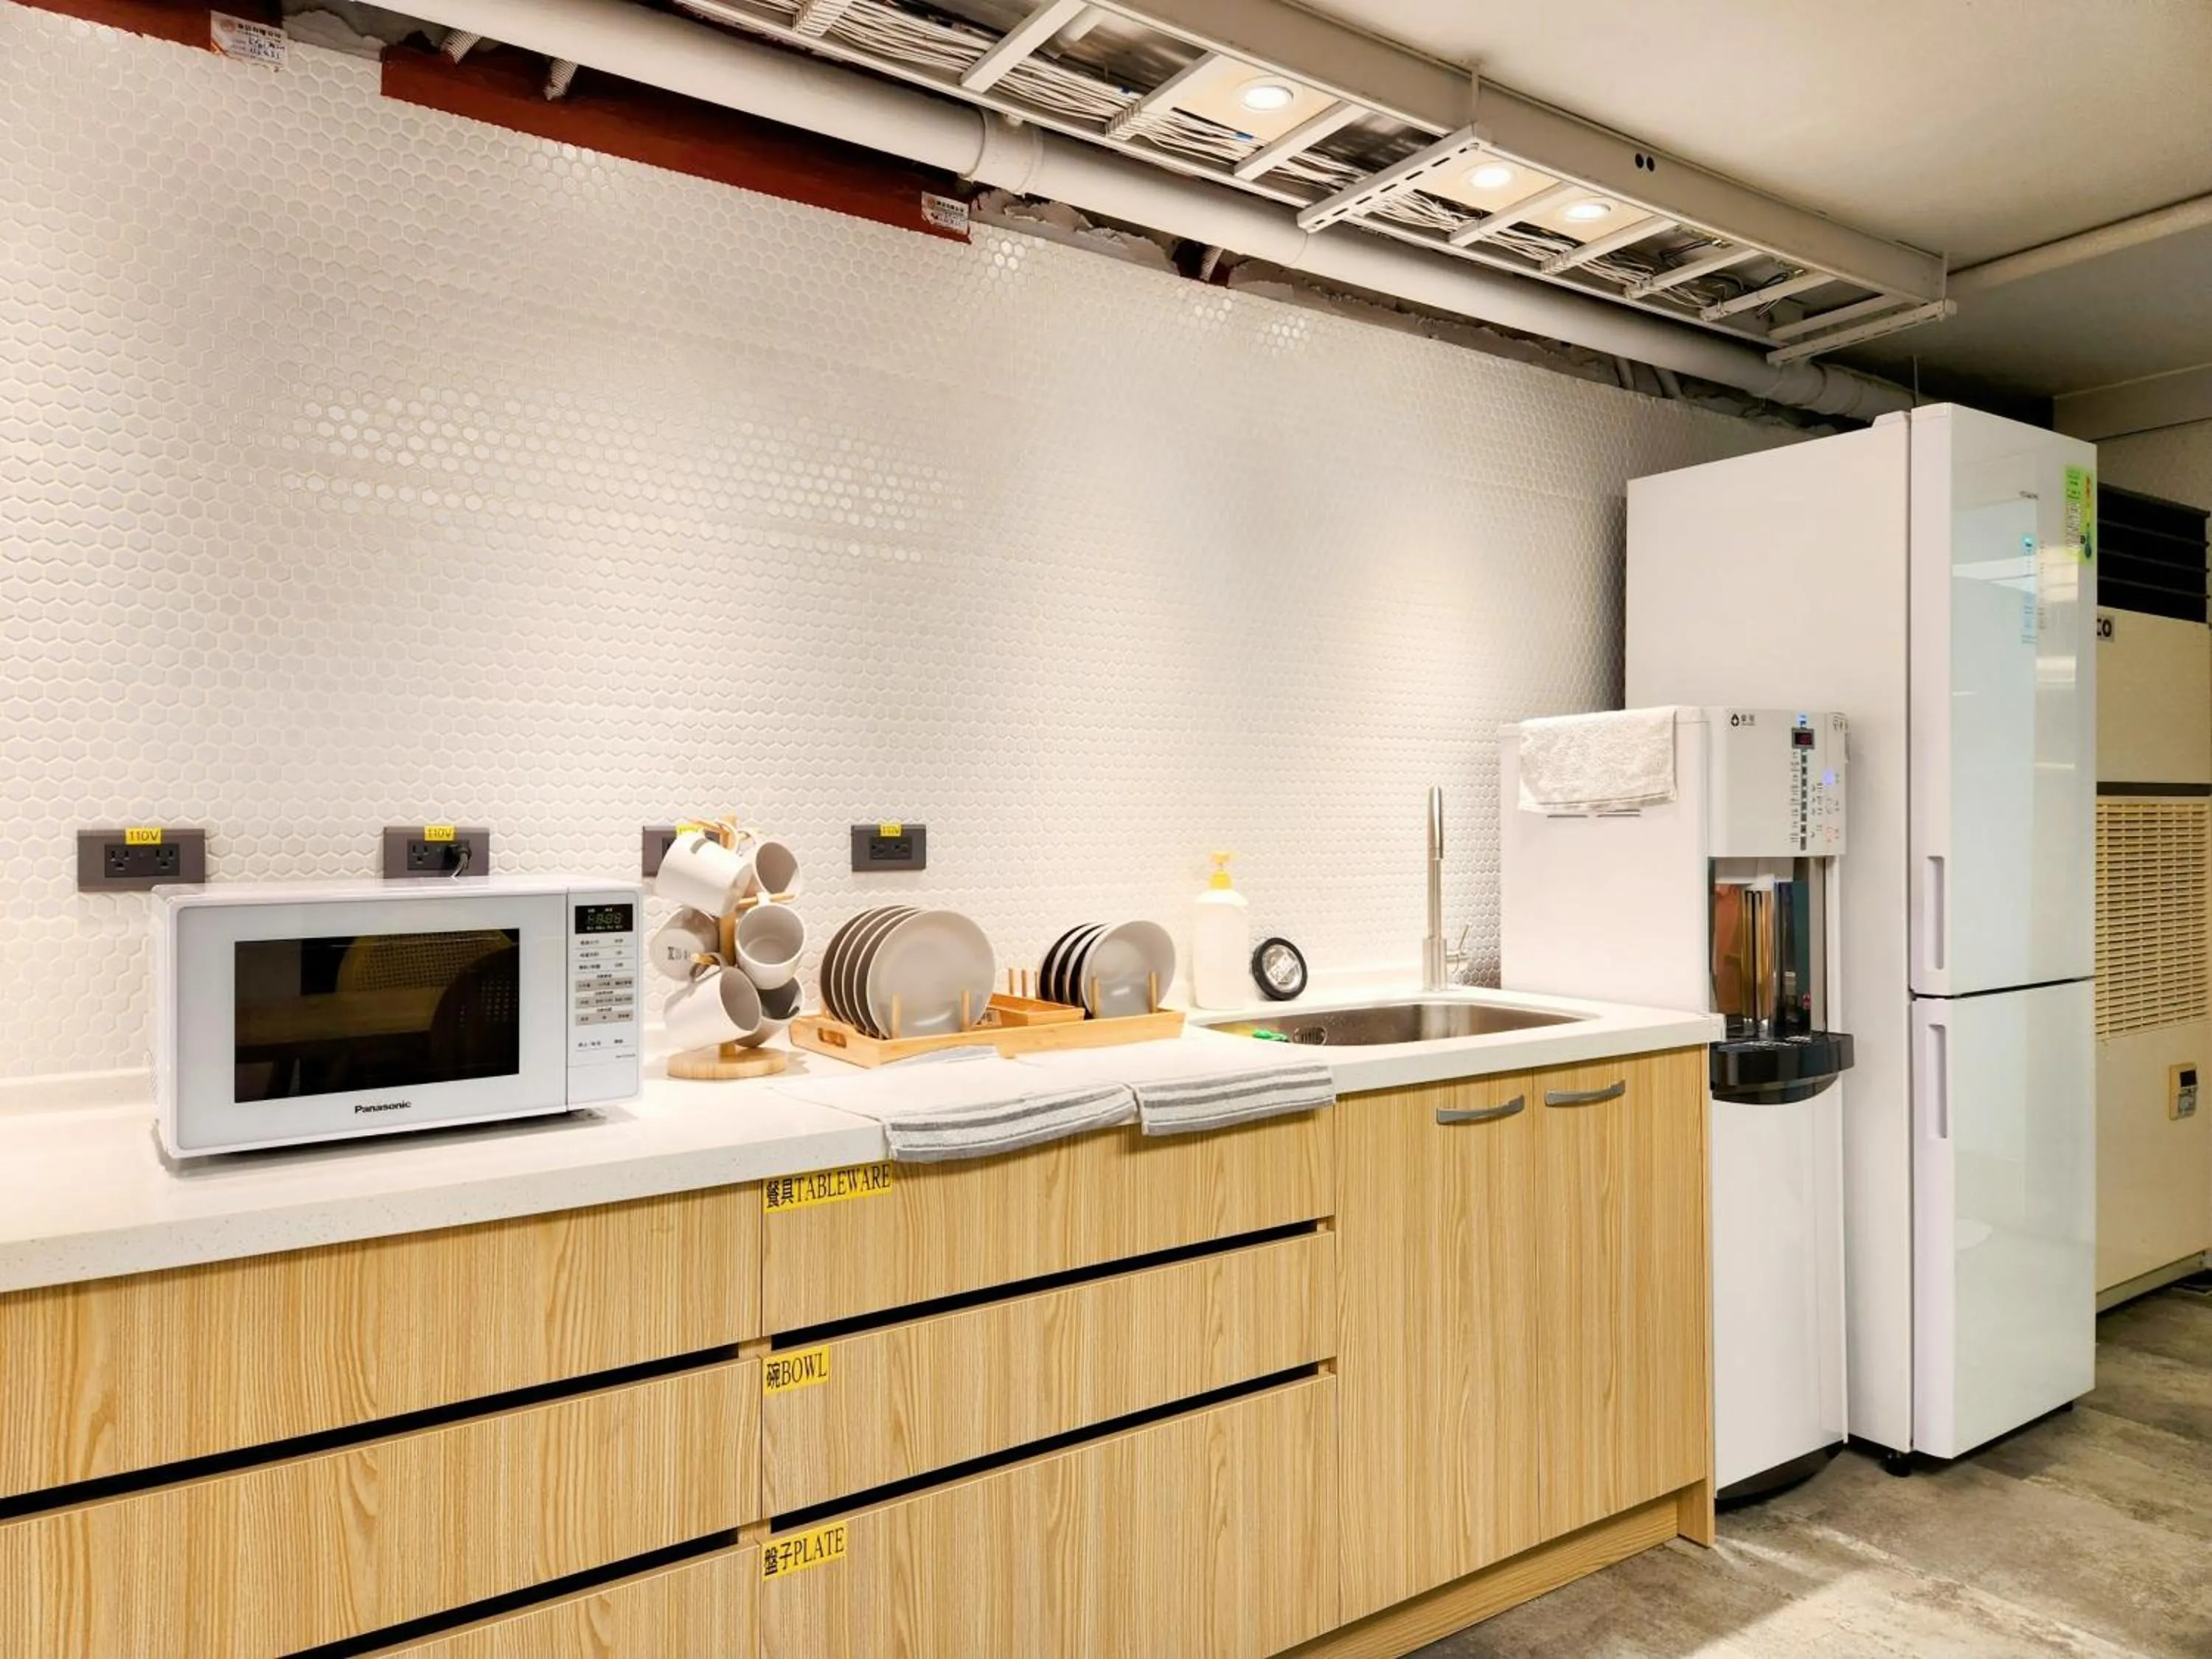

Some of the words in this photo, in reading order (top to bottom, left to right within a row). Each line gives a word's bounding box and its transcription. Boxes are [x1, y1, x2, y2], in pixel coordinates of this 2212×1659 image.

[128, 830, 159, 842] 110V
[426, 827, 453, 838] 110V
[354, 1099, 412, 1114] Panasonic
